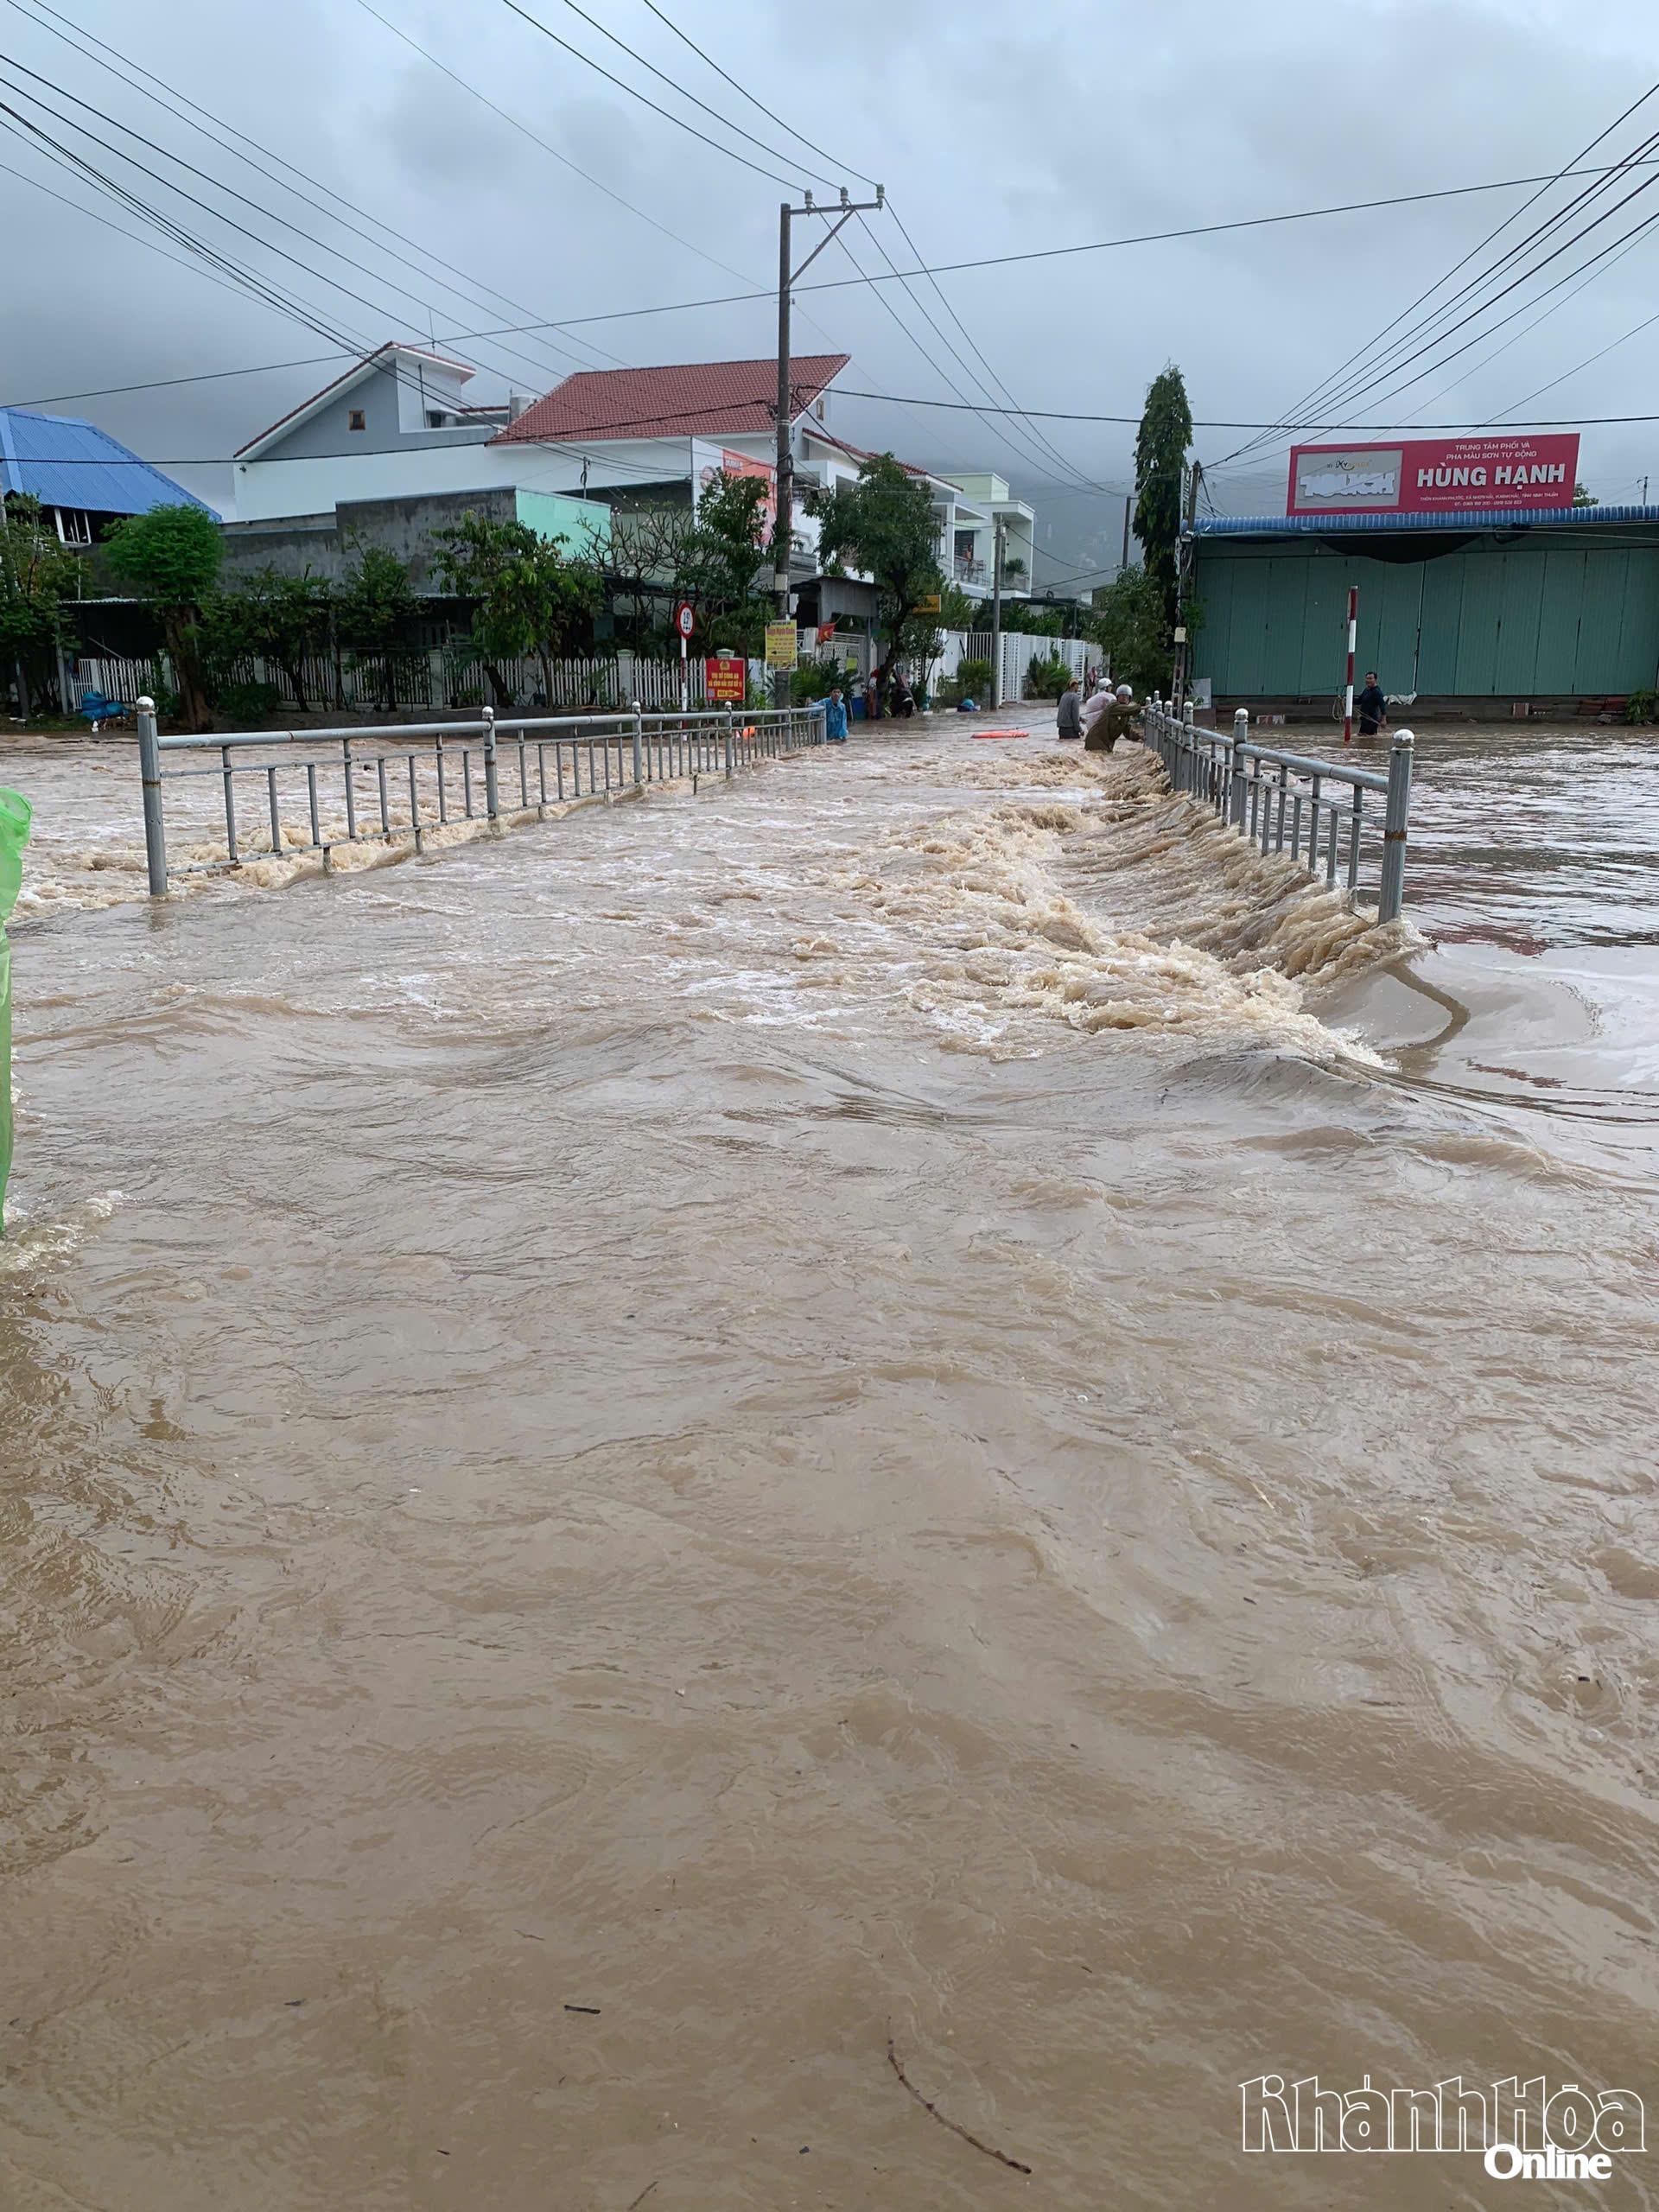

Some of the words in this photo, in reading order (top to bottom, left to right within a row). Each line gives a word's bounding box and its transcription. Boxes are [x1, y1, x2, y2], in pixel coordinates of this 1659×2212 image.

[1483, 442, 1499, 450] TÂM
[1500, 440, 1519, 449] PHỐI
[1463, 451, 1480, 460] MÀU
[1501, 451, 1513, 460] TỰ
[1515, 449, 1537, 459] ĐỘNG
[1417, 461, 1487, 487] HÙNG
[1494, 463, 1566, 490] HẠNH
